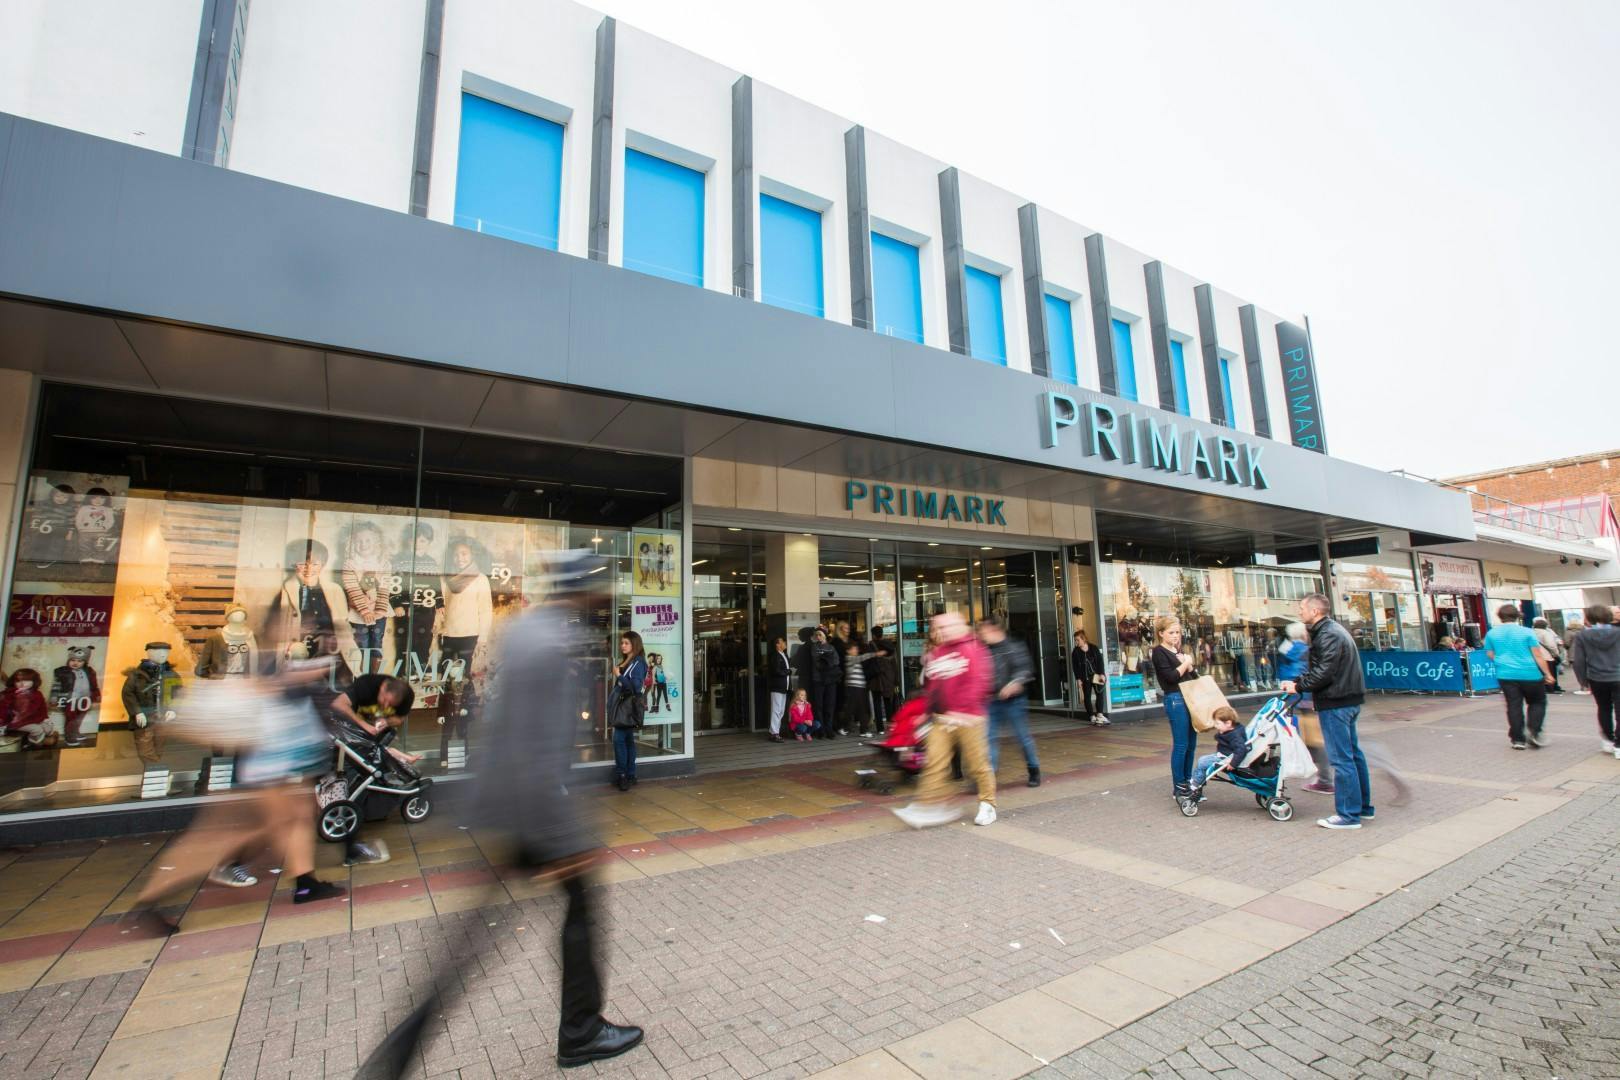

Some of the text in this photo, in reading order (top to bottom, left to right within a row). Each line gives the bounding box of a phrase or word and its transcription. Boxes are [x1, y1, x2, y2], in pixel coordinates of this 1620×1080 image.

[1285, 347, 1318, 449] PRIMAR
[1043, 391, 1271, 489] PRIMARK
[845, 480, 1008, 526] PRIMARK
[30, 518, 53, 534] £6
[96, 536, 119, 551] £7
[381, 575, 402, 595] £8
[490, 567, 512, 585] £9
[413, 588, 436, 607] £8
[1416, 661, 1455, 680] Café
[668, 687, 679, 698] £6
[57, 696, 92, 712] £10
